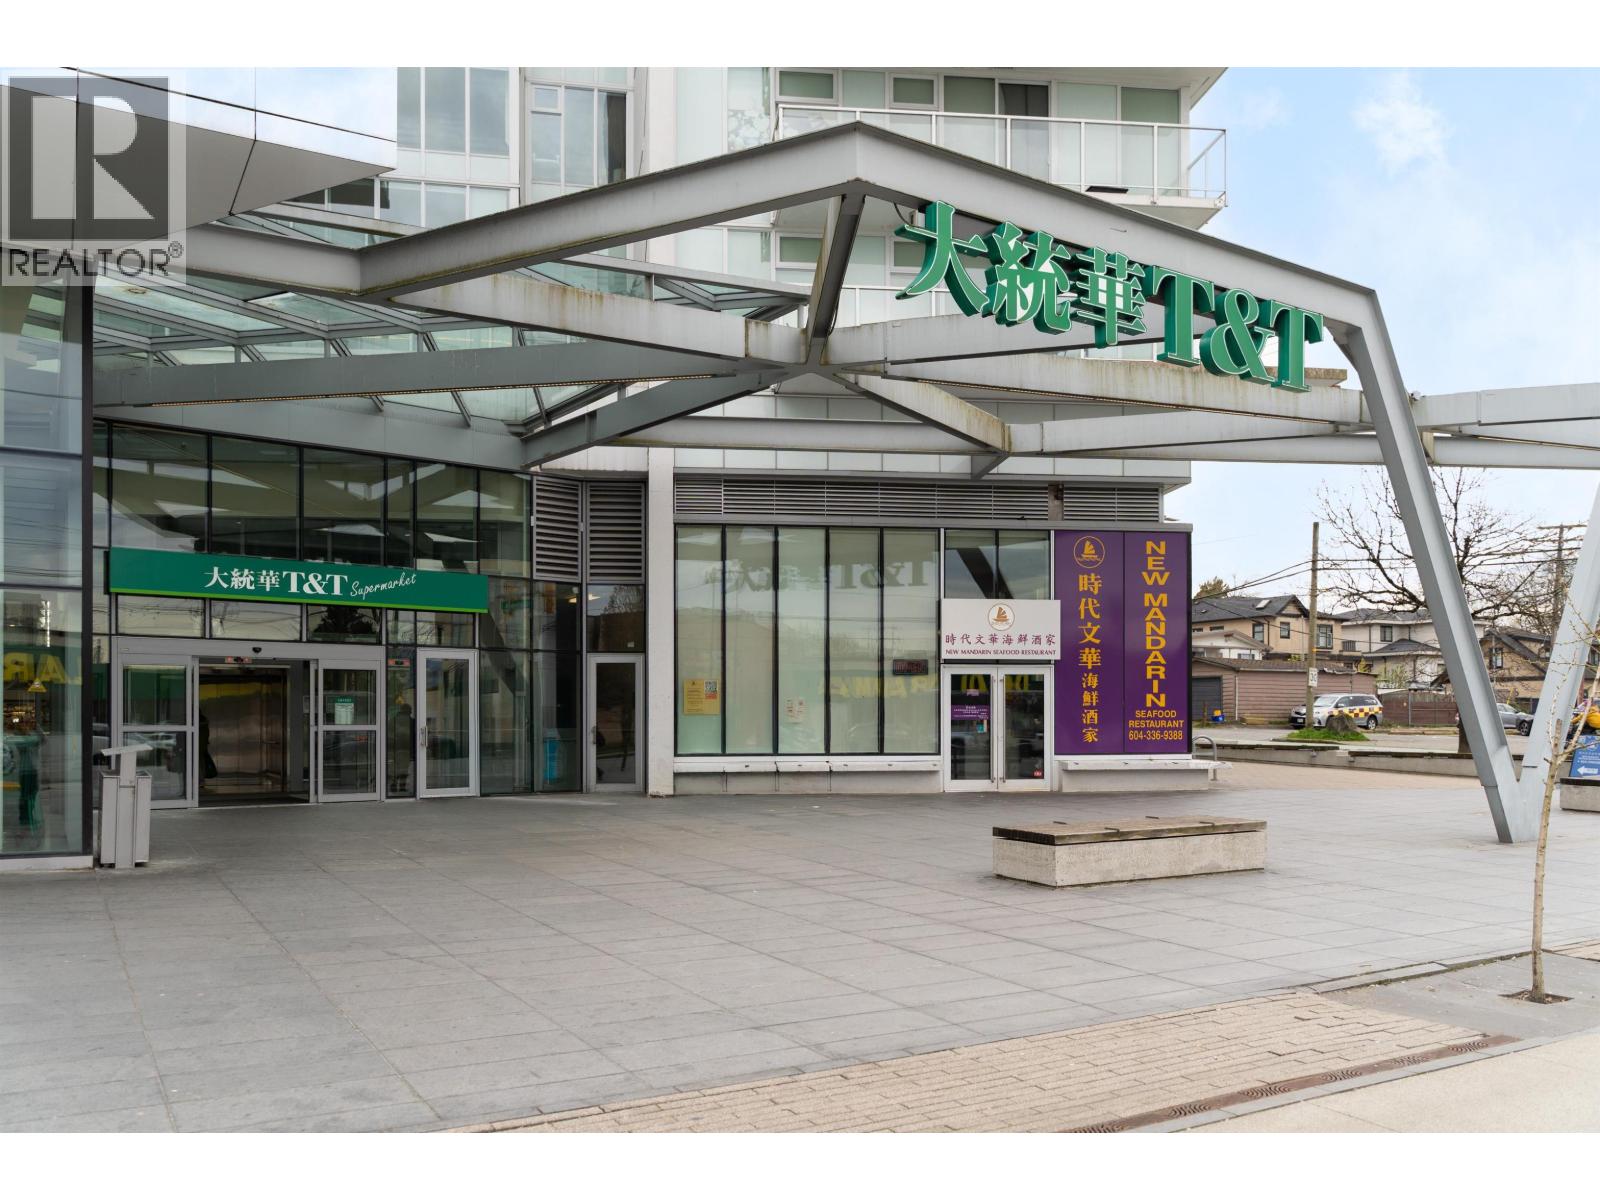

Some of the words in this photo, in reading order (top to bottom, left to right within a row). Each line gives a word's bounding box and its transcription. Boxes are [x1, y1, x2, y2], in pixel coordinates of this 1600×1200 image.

[1142, 541, 1170, 586] NEW
[350, 572, 417, 600] Supermarket
[945, 633, 1056, 646] 時代文華海鮮酒家
[1078, 573, 1102, 743] 時代文華海鮮酒家
[1144, 593, 1168, 707] MANDARIN
[1128, 720, 1184, 728] RESTAURANT
[1135, 710, 1177, 718] SEAFOOD
[1128, 730, 1183, 740] 604-336-9388
